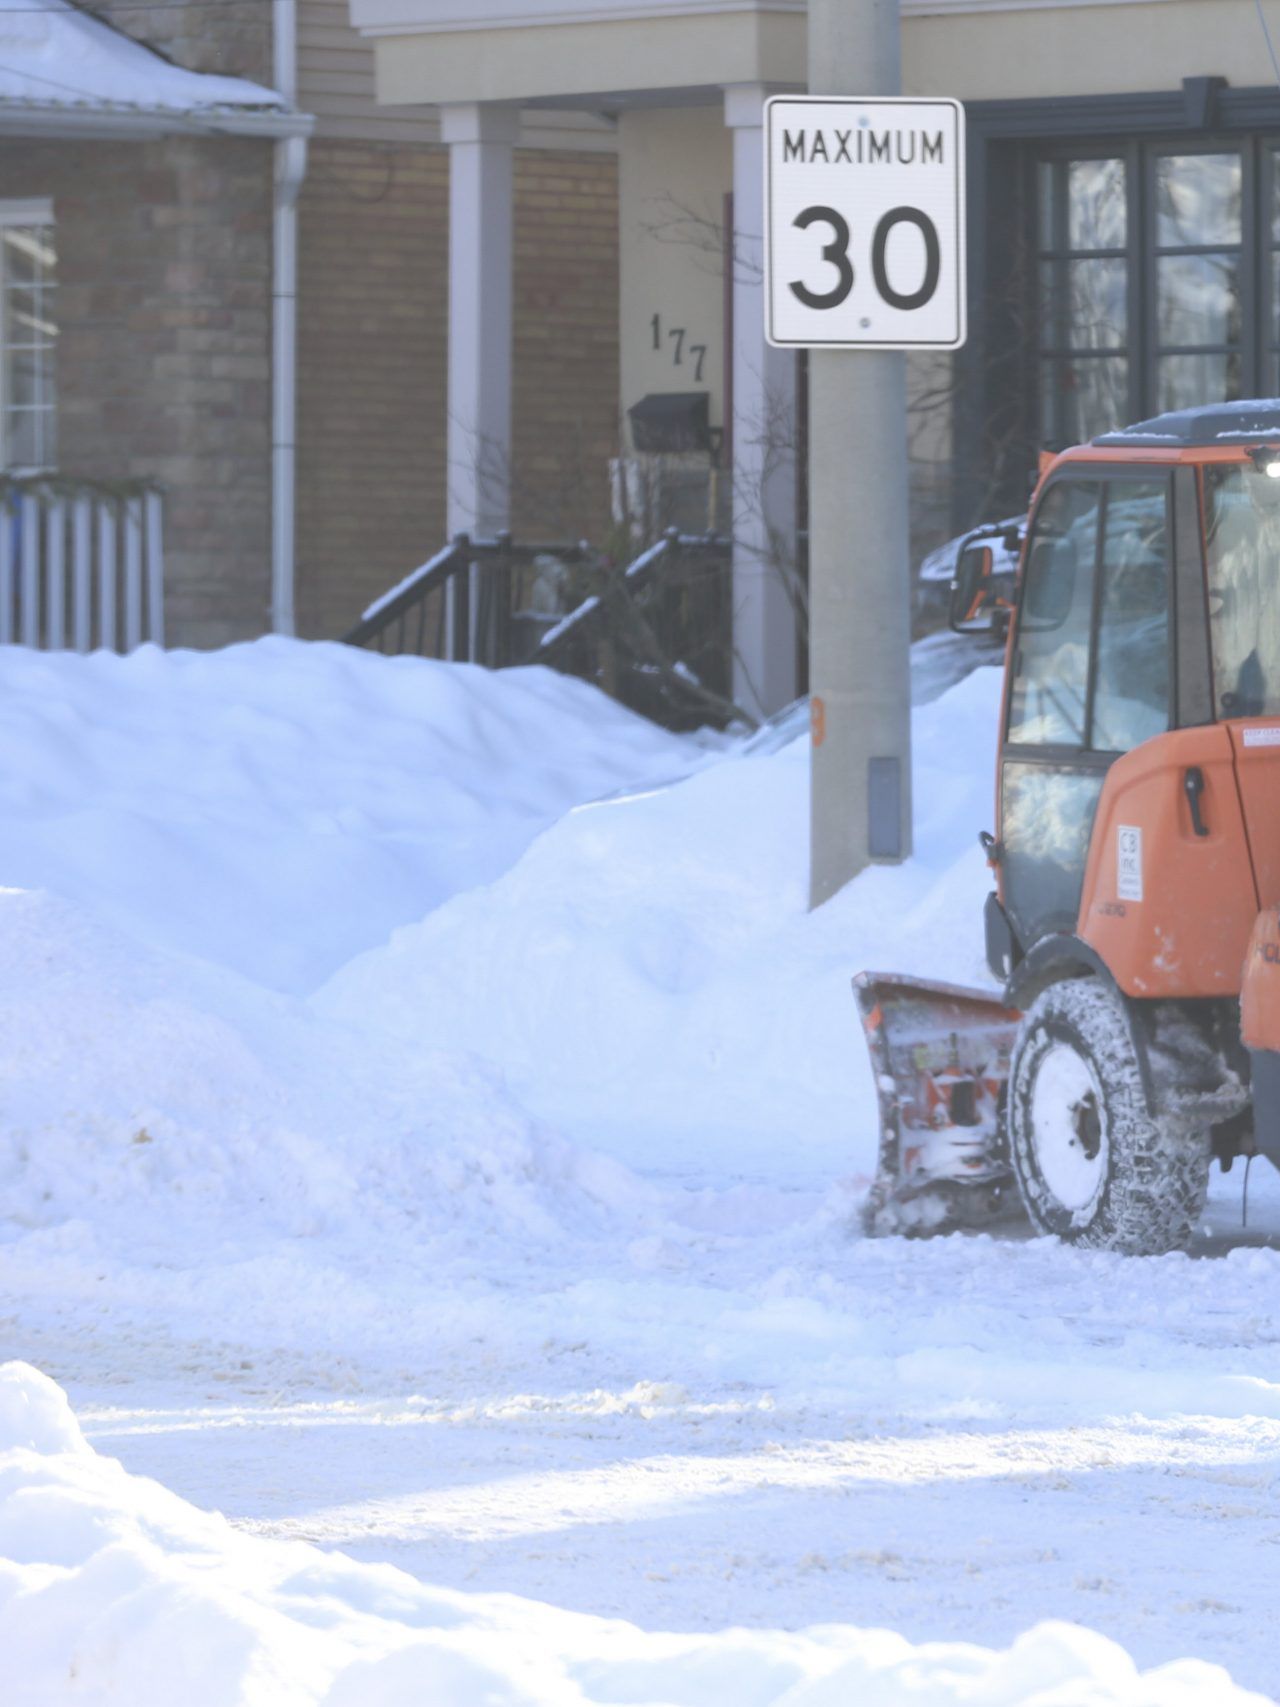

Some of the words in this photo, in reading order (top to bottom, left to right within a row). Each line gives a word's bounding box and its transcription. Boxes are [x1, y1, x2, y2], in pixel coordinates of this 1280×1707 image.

[783, 129, 944, 164] MAXIMUM
[788, 205, 942, 311] 30
[651, 312, 707, 382] 177
